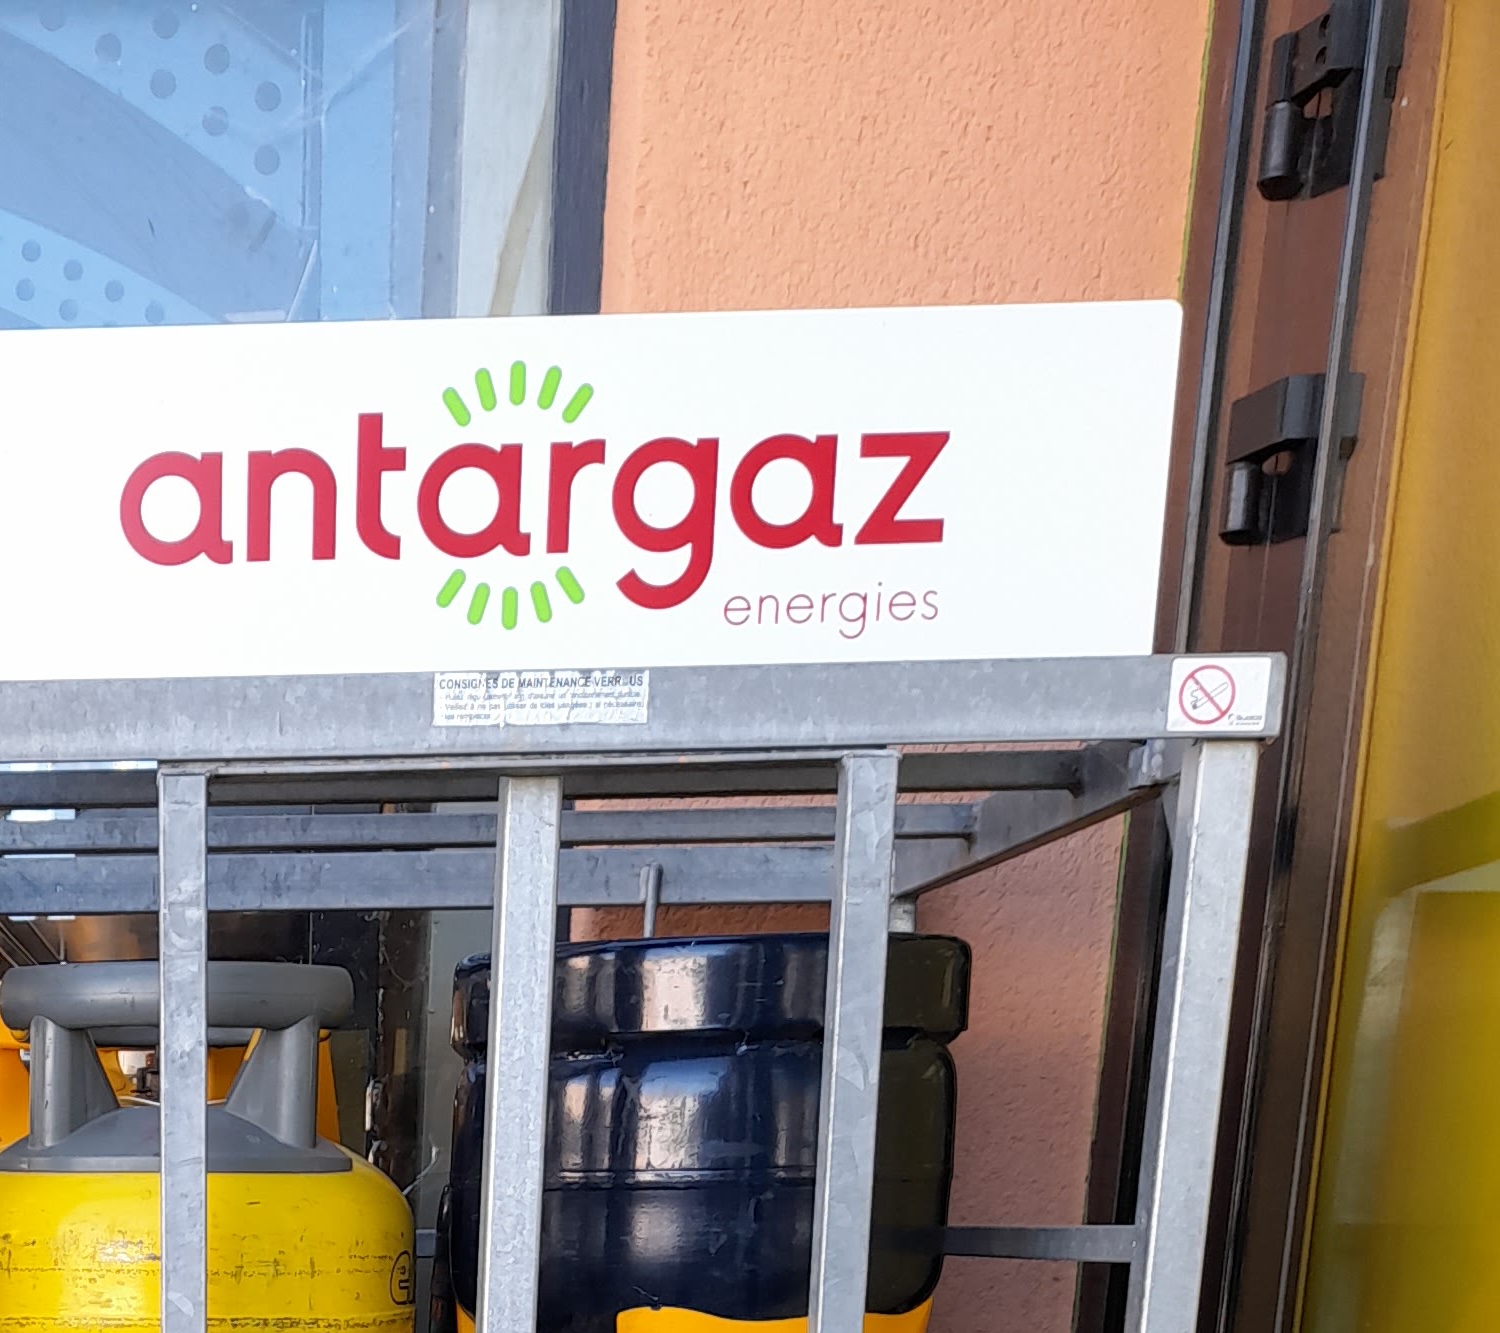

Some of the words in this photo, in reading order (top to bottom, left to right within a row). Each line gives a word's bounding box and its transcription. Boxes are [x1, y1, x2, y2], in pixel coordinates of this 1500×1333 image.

[119, 412, 950, 611] antargaz
[722, 578, 941, 638] energies
[501, 677, 515, 689] DE
[594, 675, 643, 687] VERRUS
